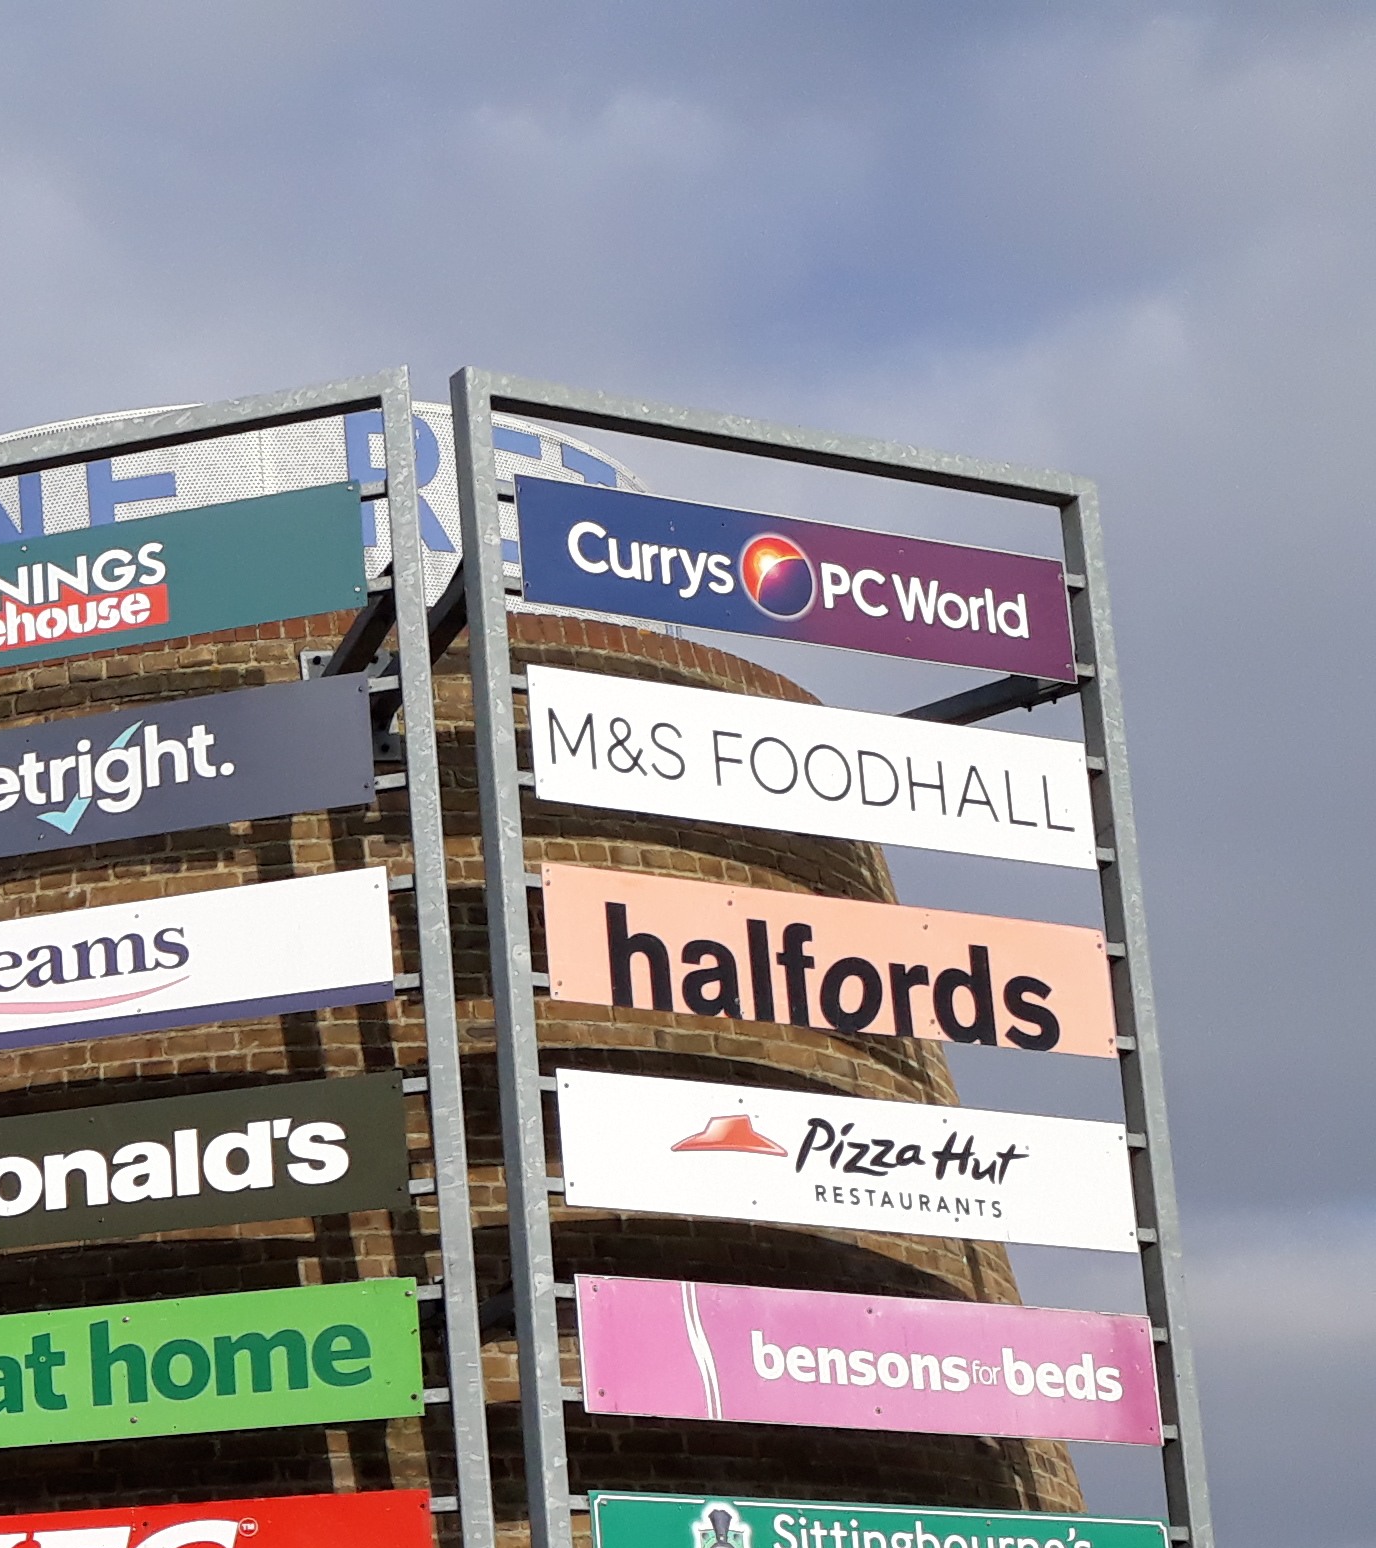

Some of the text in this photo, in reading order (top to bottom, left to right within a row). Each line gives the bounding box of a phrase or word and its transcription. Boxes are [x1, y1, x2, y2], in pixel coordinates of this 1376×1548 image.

[567, 520, 1030, 640] Currys PC World
[548, 708, 1075, 833] M&S FOODHALL
[605, 902, 1061, 1053] halfords
[795, 1117, 1029, 1184] Pizza Hut
[815, 1184, 1003, 1218] RESTAURANTS
[88, 1320, 371, 1407] home
